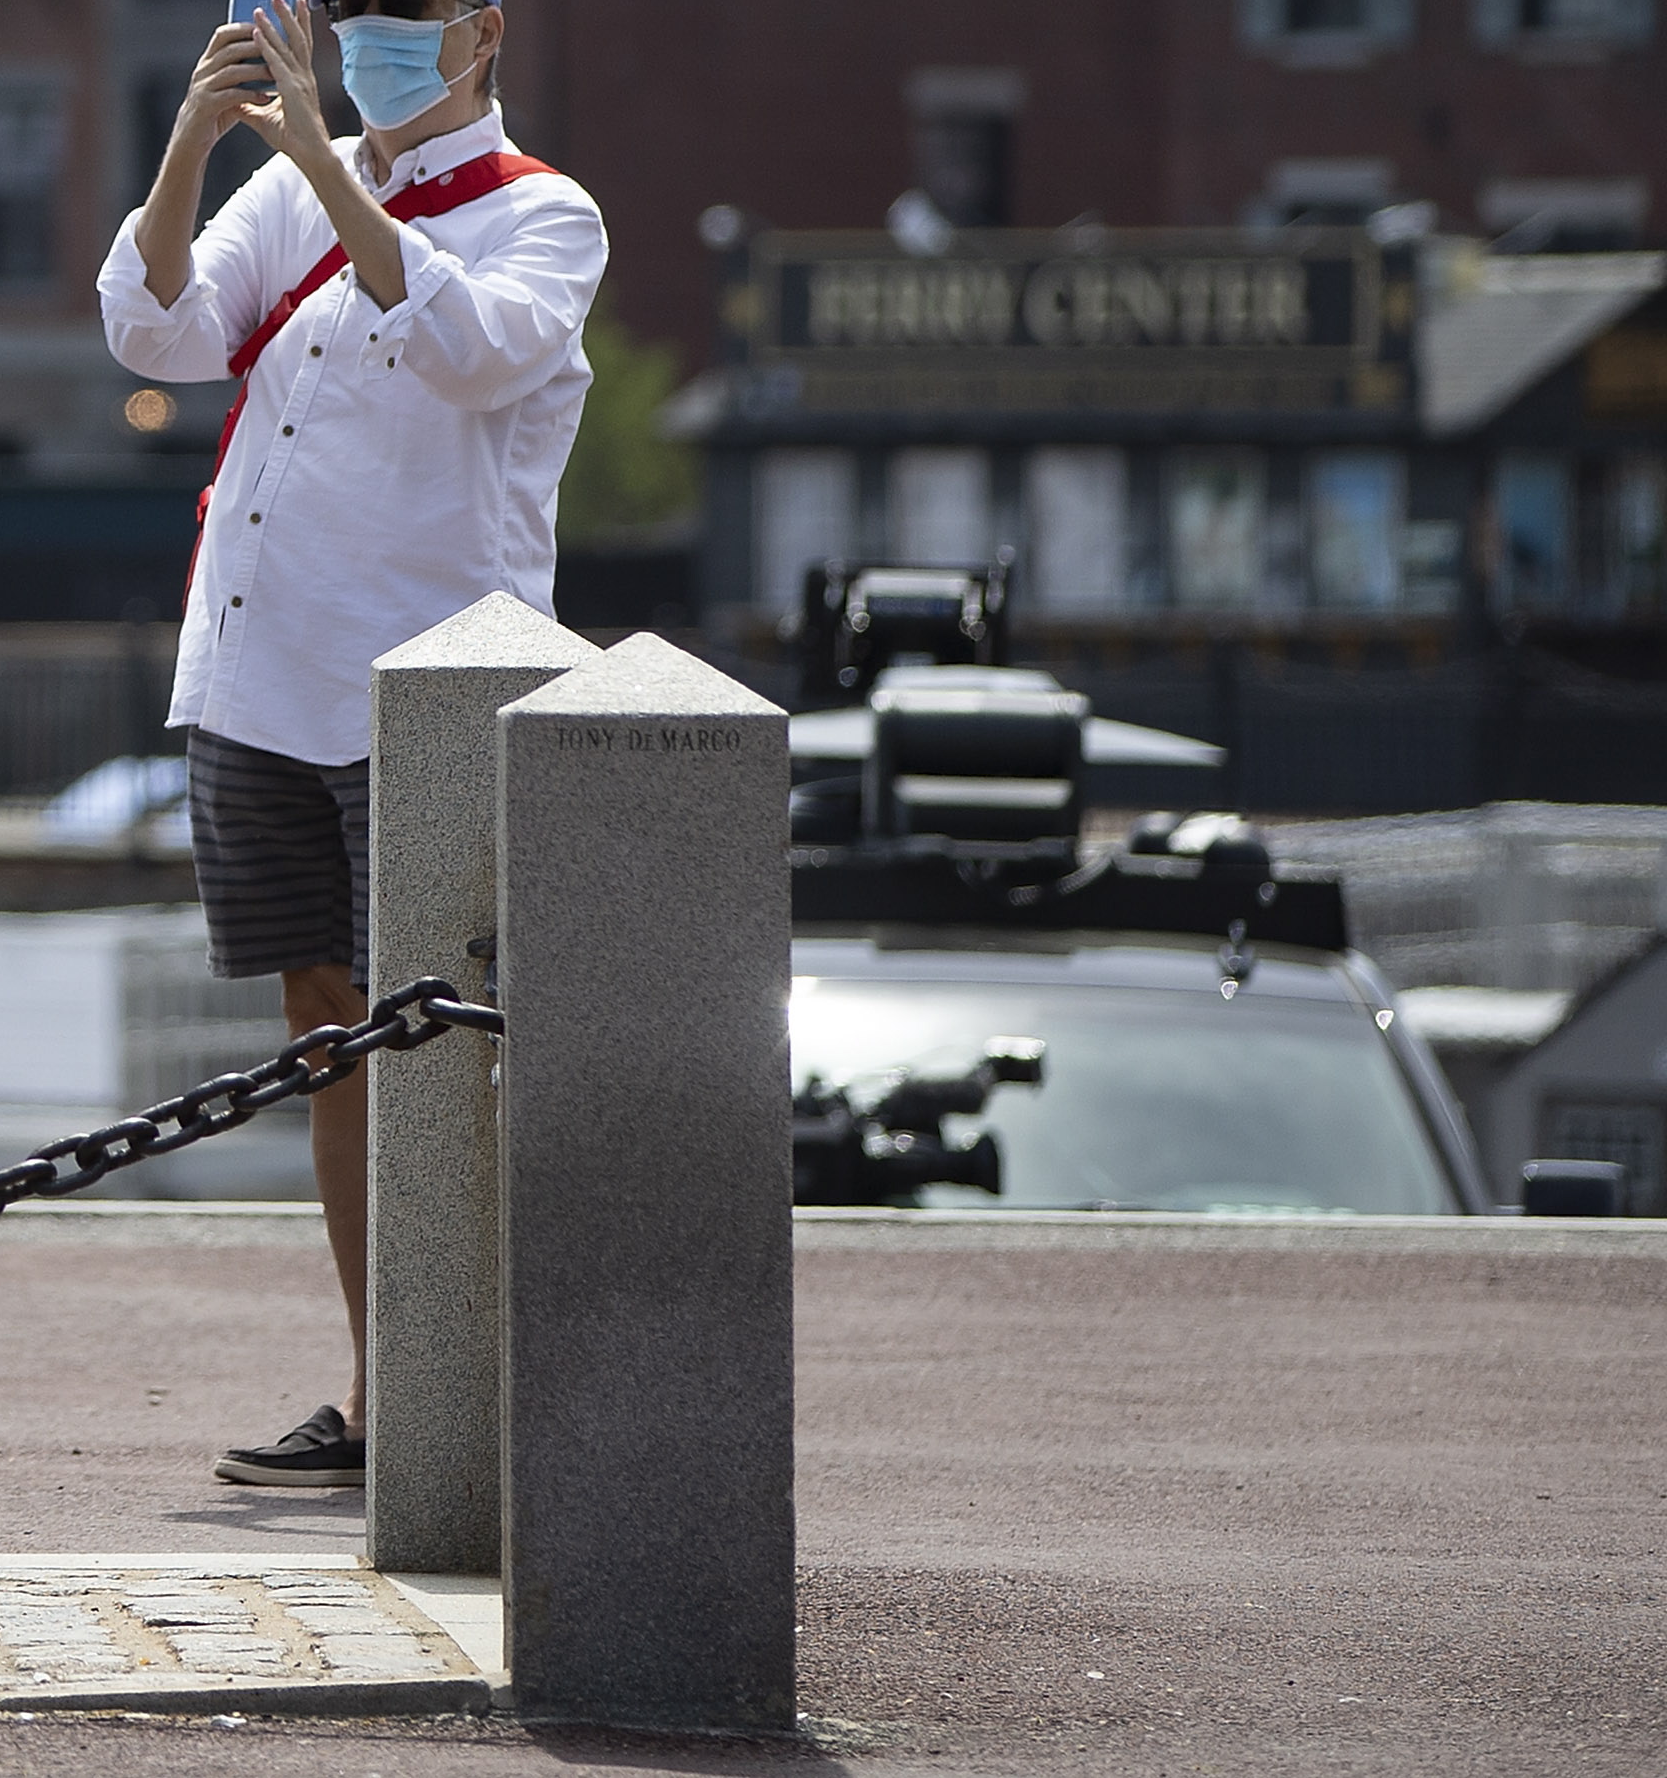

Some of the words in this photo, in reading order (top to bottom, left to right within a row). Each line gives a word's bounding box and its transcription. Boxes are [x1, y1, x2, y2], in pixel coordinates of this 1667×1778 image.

[809, 262, 1016, 345] FERRY
[1023, 262, 1310, 347] CENTER
[558, 729, 614, 751] TONY
